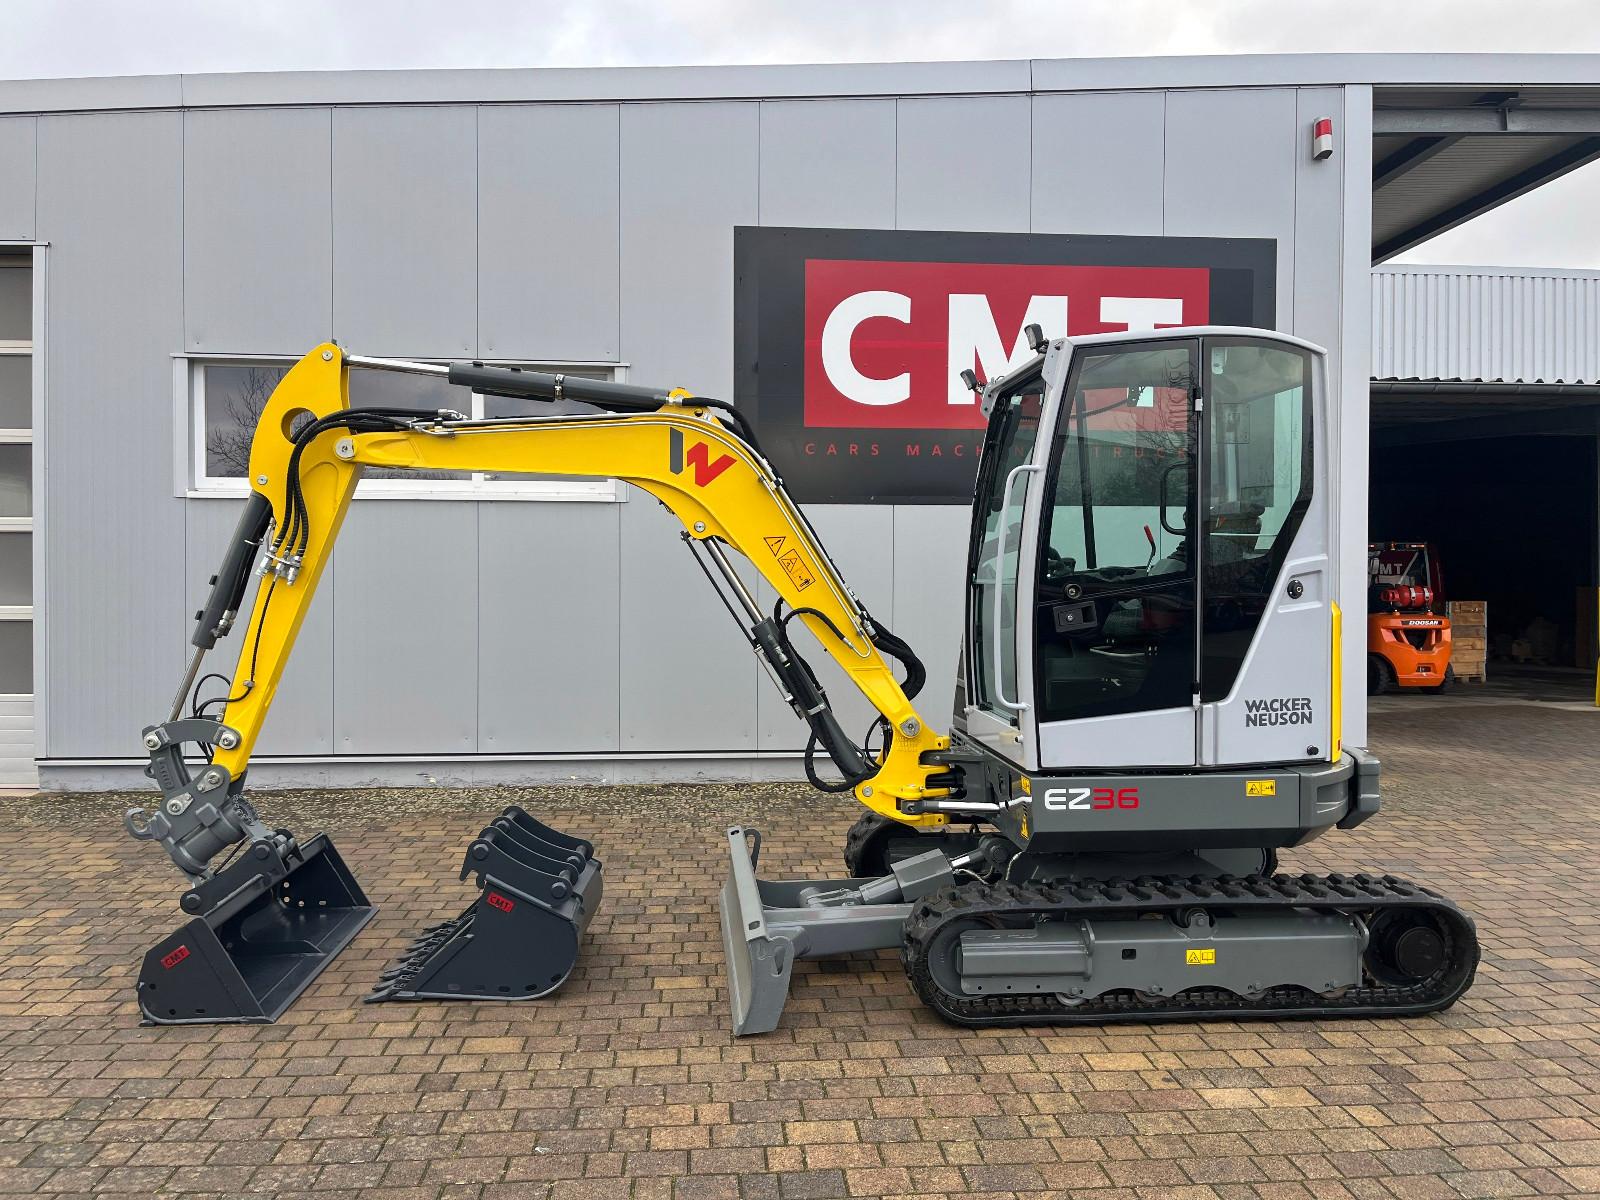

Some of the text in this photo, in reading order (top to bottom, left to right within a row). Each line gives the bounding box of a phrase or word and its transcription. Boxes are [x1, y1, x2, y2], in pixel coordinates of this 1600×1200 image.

[821, 290, 1183, 407] CMT
[805, 443, 879, 456] CARS
[1244, 697, 1312, 713] WACKER
[1245, 711, 1313, 727] NEUSON
[1044, 787, 1139, 810] EZ36
[489, 895, 512, 909] CMT
[164, 947, 187, 966] CMT
